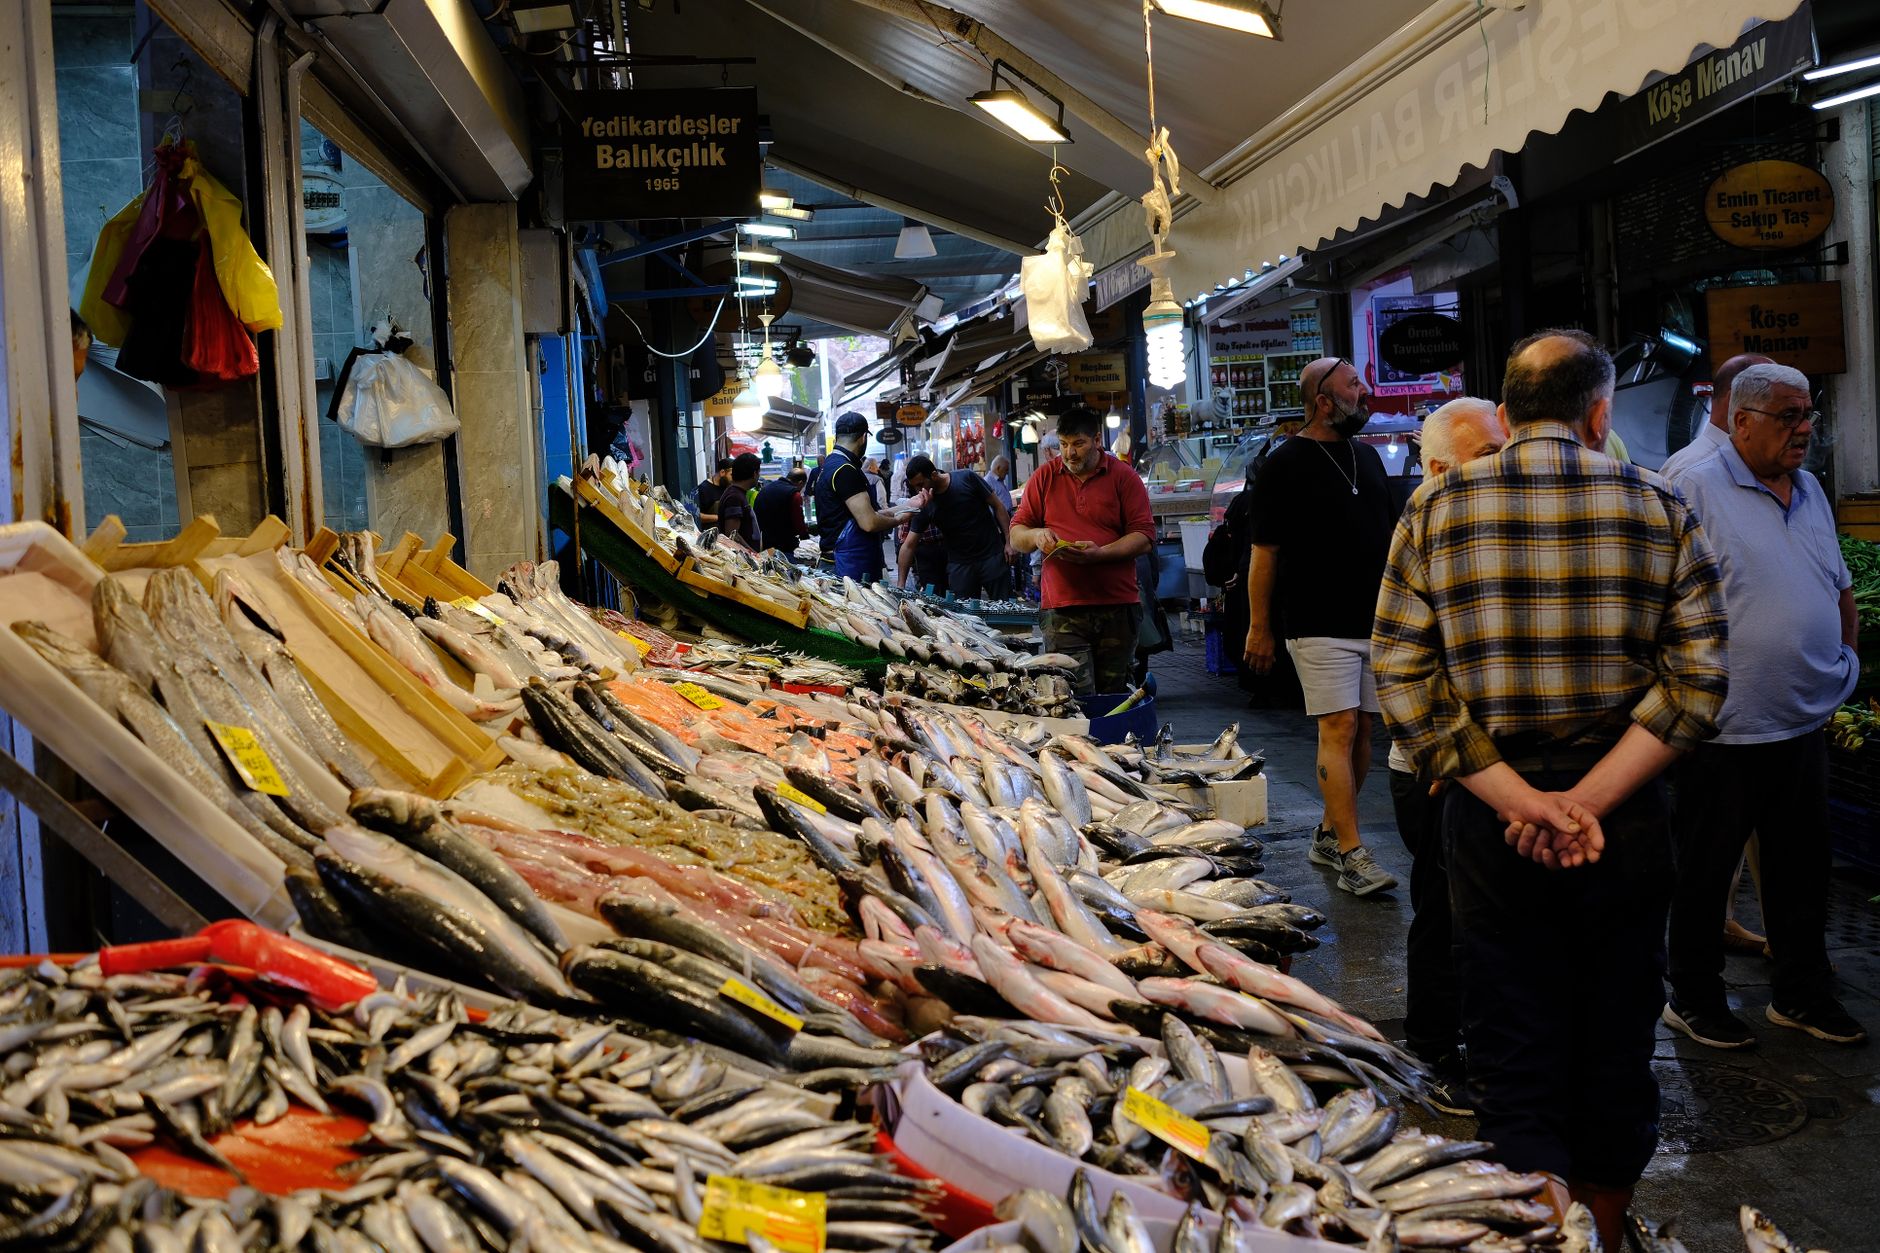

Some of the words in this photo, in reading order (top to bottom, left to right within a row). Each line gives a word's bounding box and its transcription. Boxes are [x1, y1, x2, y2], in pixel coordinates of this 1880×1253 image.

[1647, 77, 1692, 125] Köşe
[1696, 37, 1767, 100] Manav
[581, 114, 742, 141] Yedikardeşler
[596, 142, 727, 175] Balıkçılık
[645, 178, 680, 191] 1965
[1717, 191, 1758, 208] Emin
[1763, 187, 1821, 205] Ticaret
[1731, 210, 1778, 229] Sakıp
[1782, 208, 1810, 228] Taş
[1759, 231, 1784, 241] 1960
[1750, 308, 1800, 334] Köşe
[1408, 325, 1442, 339] Örnek
[1393, 341, 1459, 356] Tavukçuluk
[1743, 335, 1810, 353] Manav
